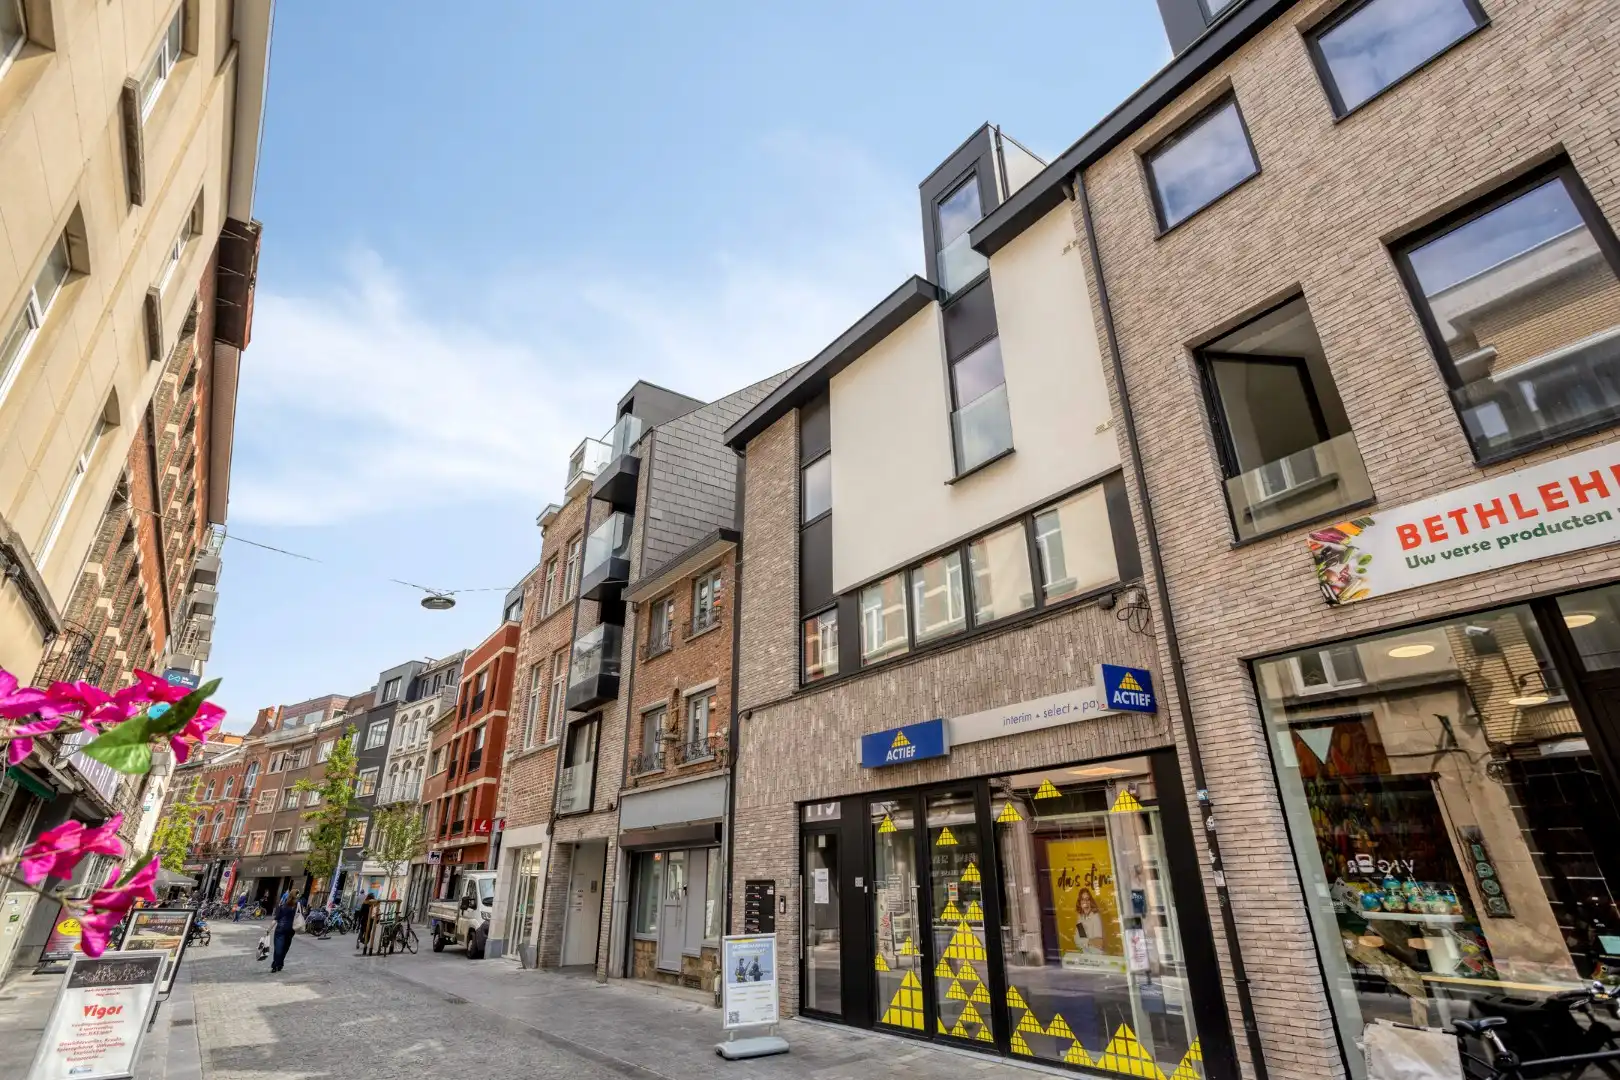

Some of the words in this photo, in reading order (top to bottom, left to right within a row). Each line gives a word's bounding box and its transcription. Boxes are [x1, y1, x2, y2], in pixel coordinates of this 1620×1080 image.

[1396, 463, 1620, 551] BETHLEH
[1405, 553, 1436, 570] Uw
[1443, 539, 1491, 561] verse
[1495, 508, 1613, 550] producten
[1113, 690, 1151, 707] ACTIEF
[1003, 711, 1032, 727] interim
[1043, 704, 1071, 719] select
[886, 745, 917, 762] ACTIEF
[83, 1004, 124, 1020] Vigor
